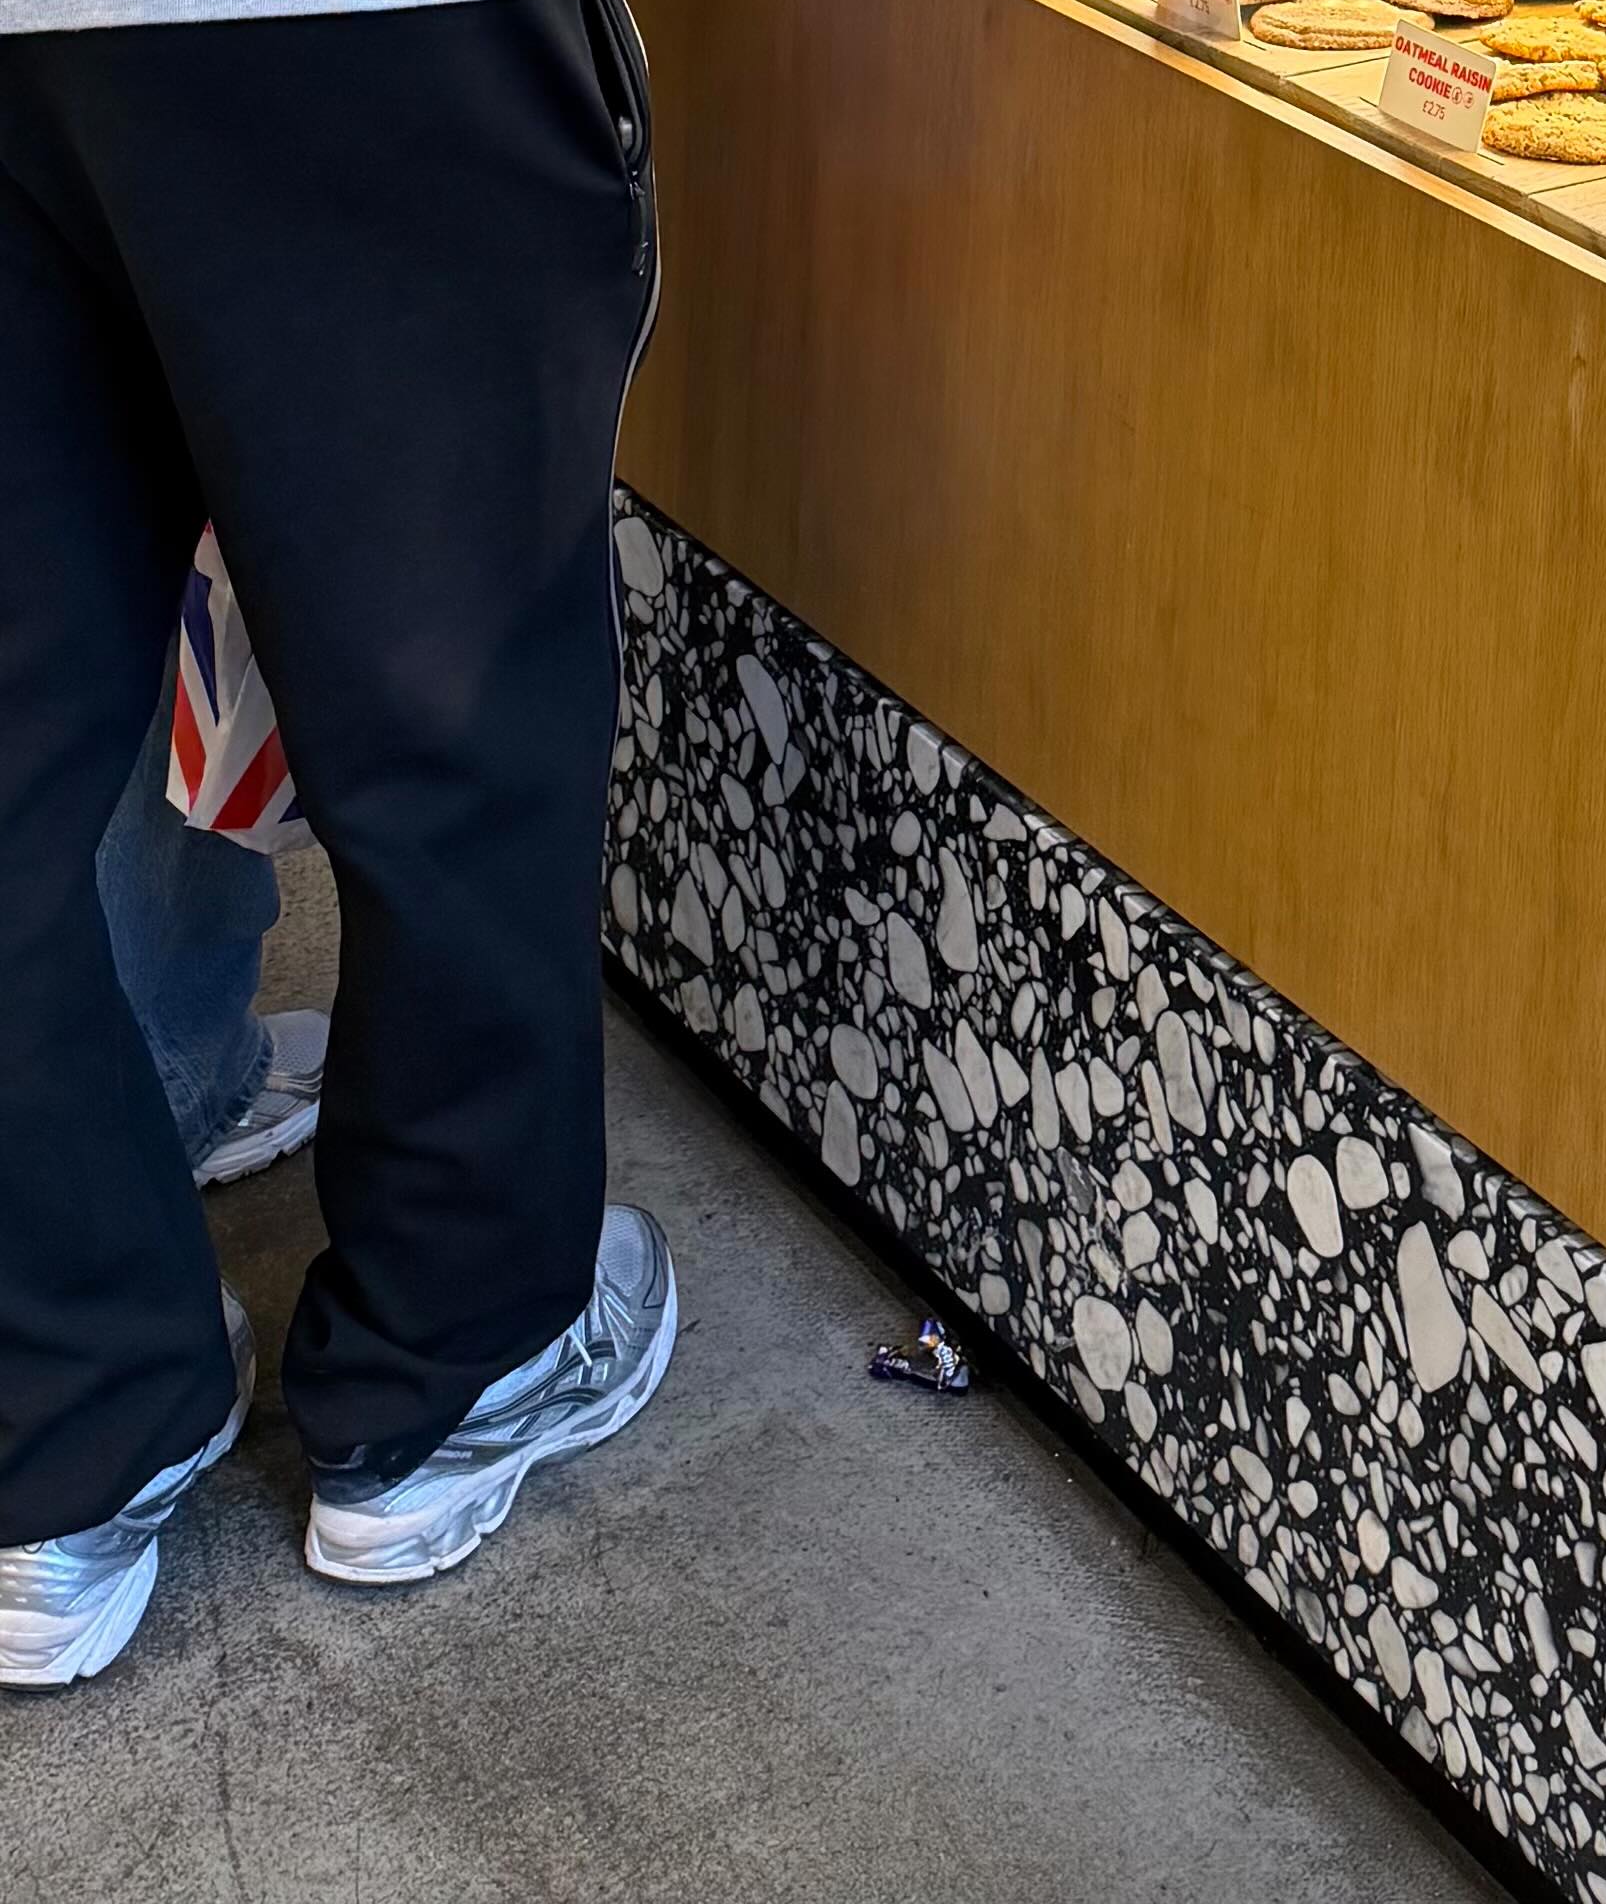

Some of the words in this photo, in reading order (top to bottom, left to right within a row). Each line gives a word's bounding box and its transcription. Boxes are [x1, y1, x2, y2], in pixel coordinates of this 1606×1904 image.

[1395, 35, 1449, 74] OATMEAL
[1450, 61, 1493, 94] RAISIN
[1408, 67, 1452, 100] COOKIE
